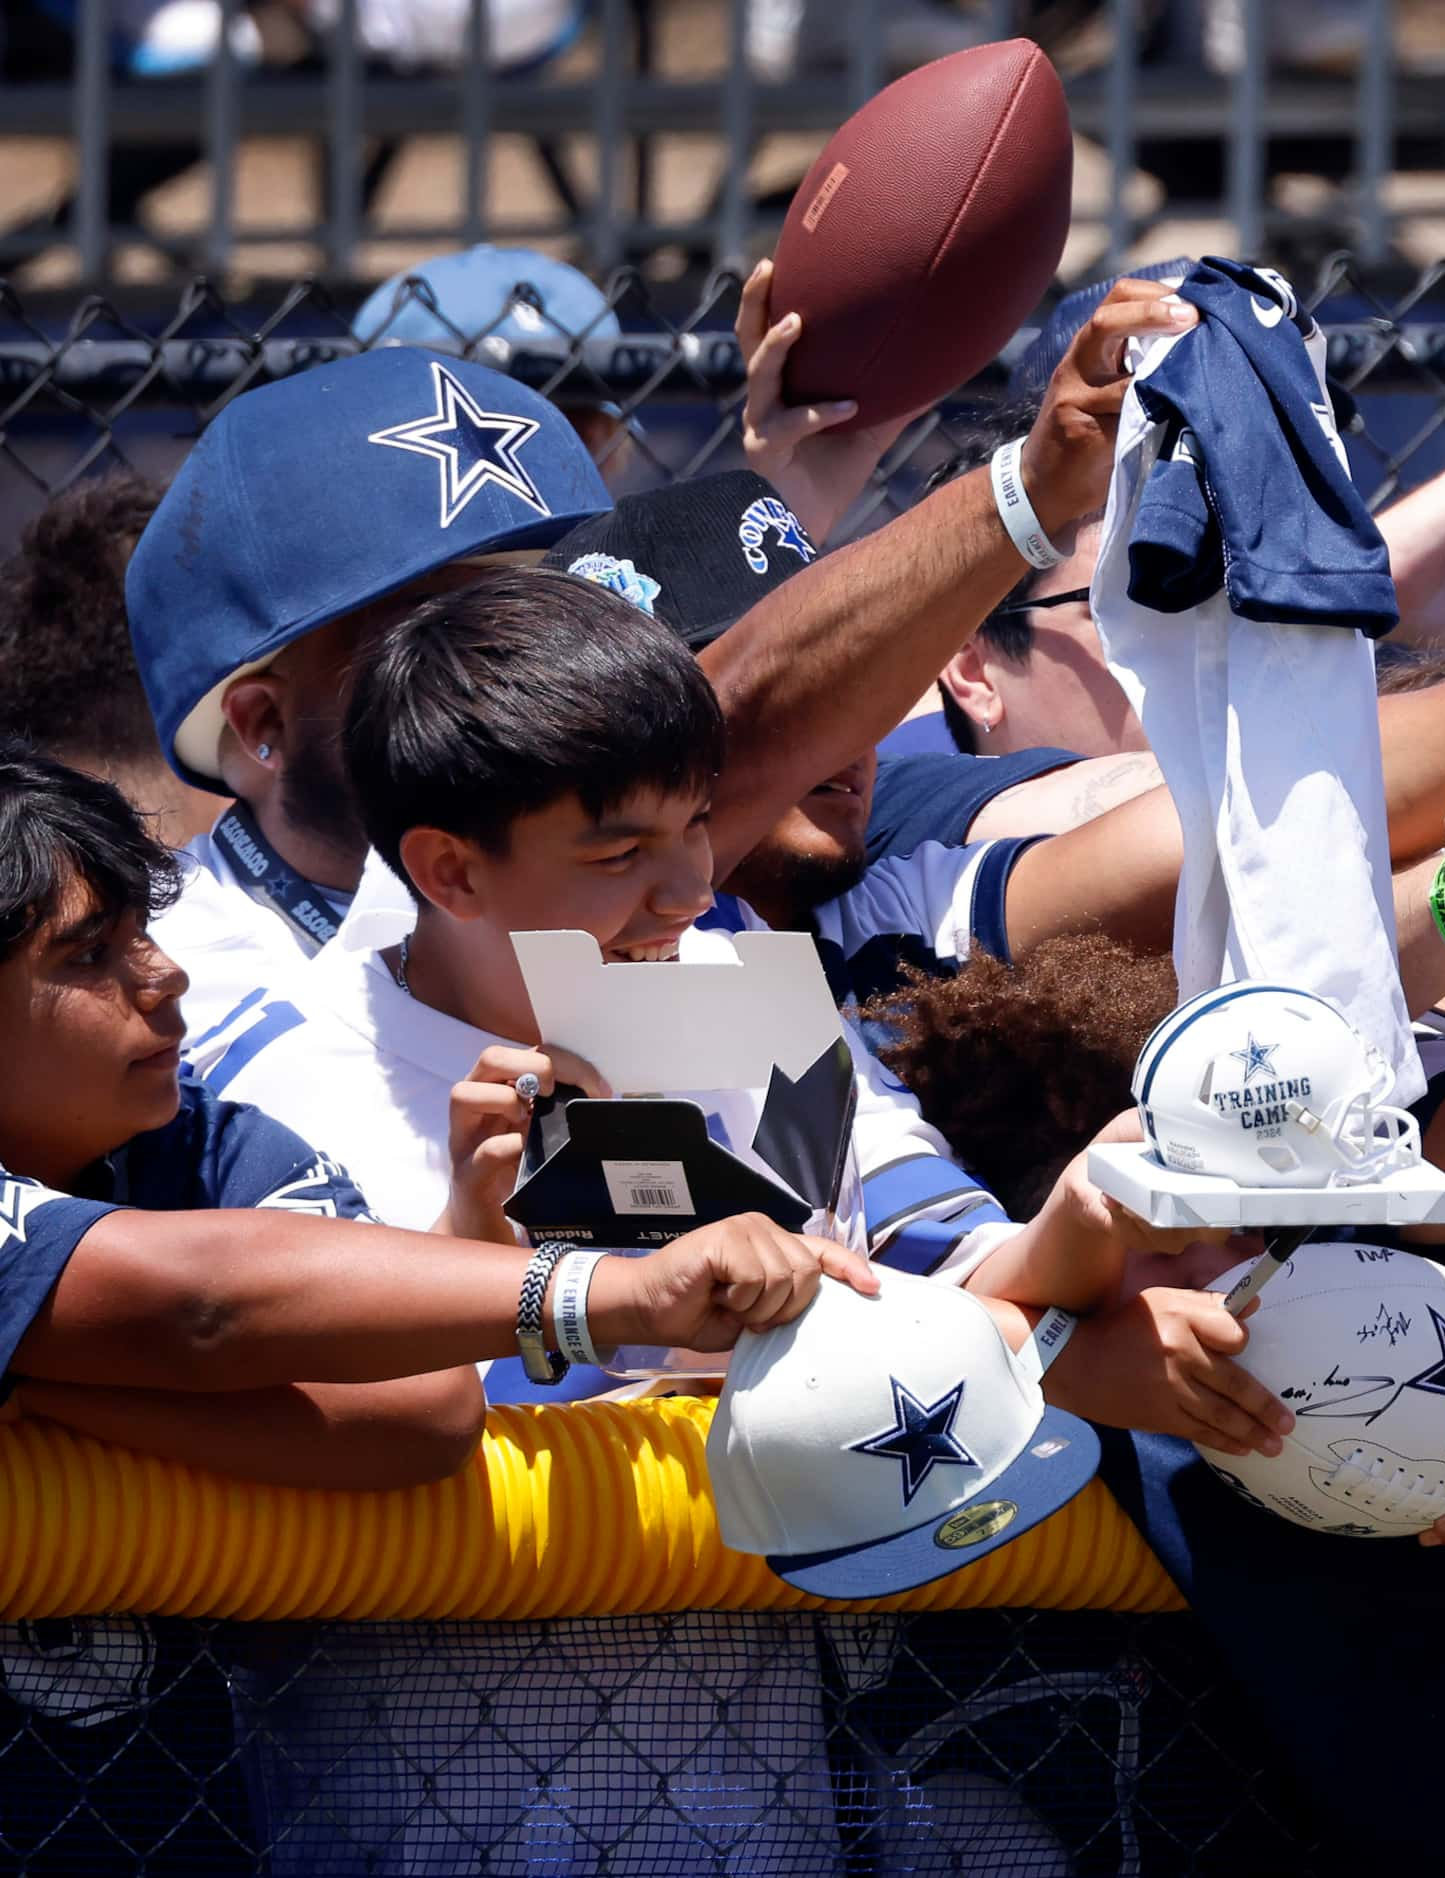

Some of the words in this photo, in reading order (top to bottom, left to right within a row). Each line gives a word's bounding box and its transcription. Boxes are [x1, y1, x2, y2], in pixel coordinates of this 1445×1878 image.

[1000, 470, 1020, 508] EARLY
[219, 815, 270, 878] COWBOYS
[1213, 1077, 1312, 1112] TRAINING
[533, 1229, 594, 1241] Riddell
[562, 1288, 582, 1347] ENTRANCE
